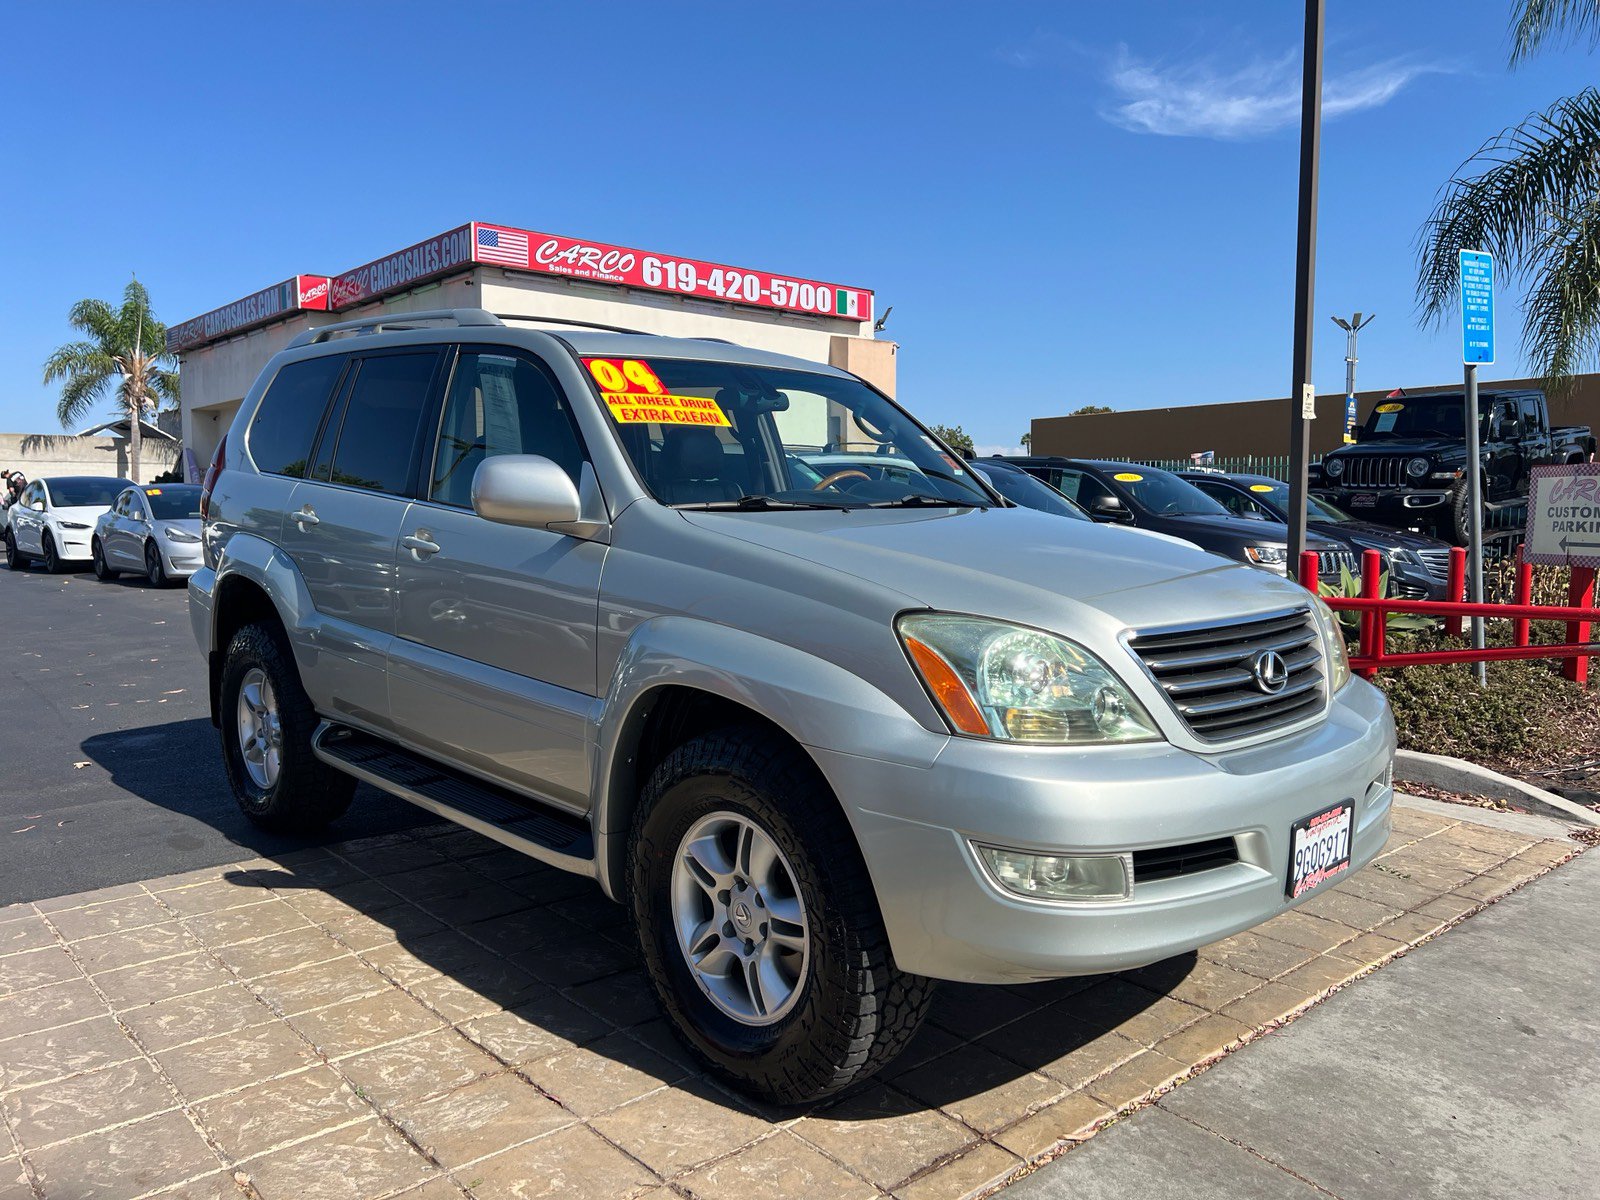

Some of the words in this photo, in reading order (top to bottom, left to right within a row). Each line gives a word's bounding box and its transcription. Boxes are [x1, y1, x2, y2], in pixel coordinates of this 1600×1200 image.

[370, 228, 470, 293] CARCOSALES.COM
[535, 240, 636, 274] CARCO
[548, 263, 572, 274] Sales
[574, 267, 590, 277] and
[592, 270, 624, 281] Finance
[300, 283, 327, 303] CARCO
[641, 255, 832, 313] 619-420-5700
[204, 288, 279, 338] CARCOSALES.COM
[589, 359, 664, 394] 04
[608, 395, 632, 405] ALL
[634, 395, 678, 407] WHEEL
[679, 398, 716, 410] DRIVE
[620, 408, 672, 421] EXTRA
[674, 409, 721, 424] CLEAN
